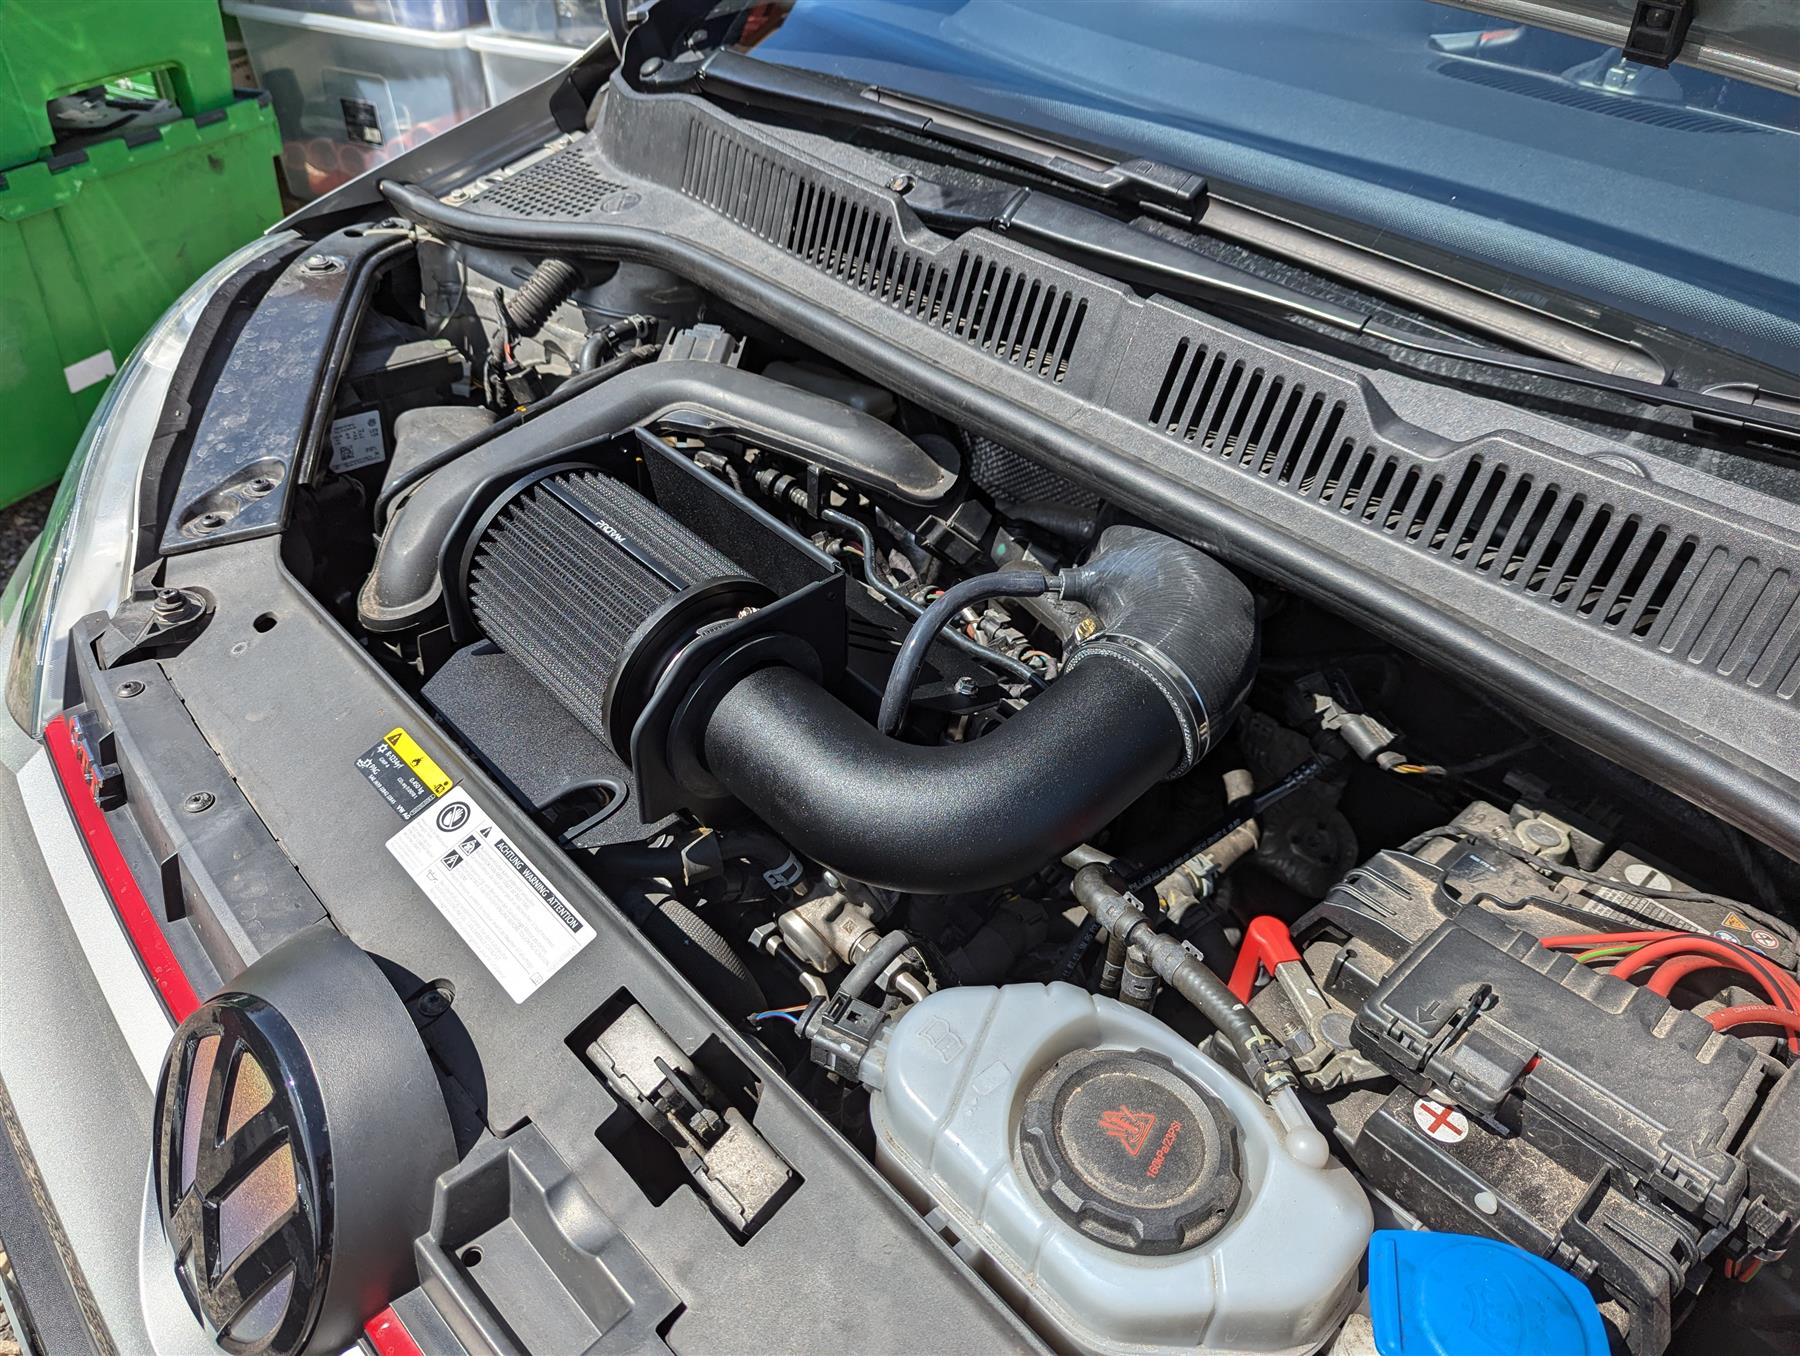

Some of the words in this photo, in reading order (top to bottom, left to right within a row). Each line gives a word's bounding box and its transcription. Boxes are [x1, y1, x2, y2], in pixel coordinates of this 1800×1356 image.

[595, 520, 626, 542] PRORAM
[396, 804, 405, 813] VW
[402, 811, 411, 820] AG
[496, 841, 524, 870] ACHTUNG
[522, 868, 549, 897] WARNING
[547, 895, 579, 929] ATTENTION
